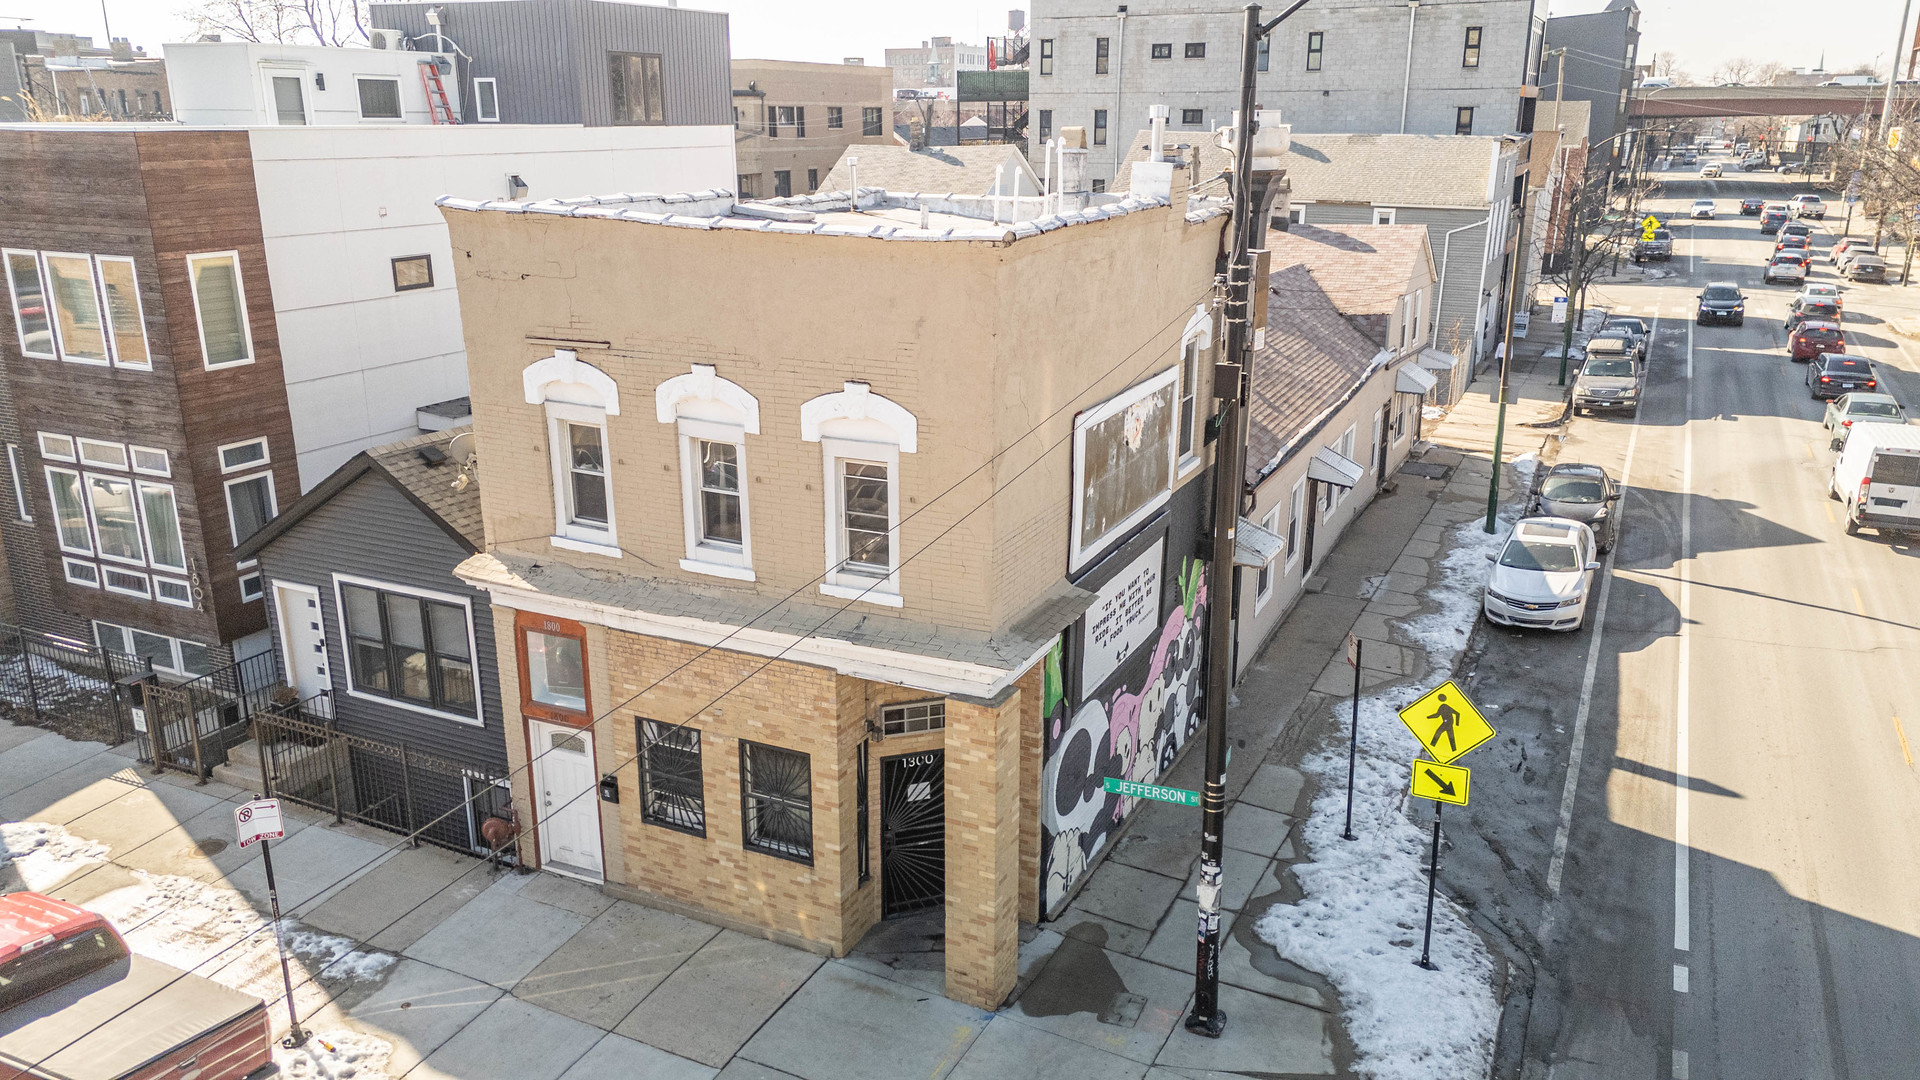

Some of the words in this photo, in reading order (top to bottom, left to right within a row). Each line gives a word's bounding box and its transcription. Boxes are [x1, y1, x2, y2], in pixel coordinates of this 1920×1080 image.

[1115, 588, 1126, 603] YOU
[1127, 575, 1141, 592] WANT
[1143, 567, 1150, 578] TO
[1091, 607, 1117, 635] IMPRESS
[1119, 598, 1126, 611] ME
[1128, 585, 1142, 603] WITH
[1143, 572, 1156, 588] YOUR
[1115, 613, 1122, 626] IT
[1125, 594, 1144, 617] BETTER
[1145, 586, 1153, 598] BE
[543, 620, 561, 632] 1800
[1102, 639, 1107, 649] A
[1109, 624, 1124, 643] FOOD
[1105, 781, 1110, 789] S
[1115, 781, 1186, 803] JEFFERSON
[1190, 795, 1198, 803] ST
[242, 836, 256, 847] TOW
[260, 831, 279, 840] ZONE
